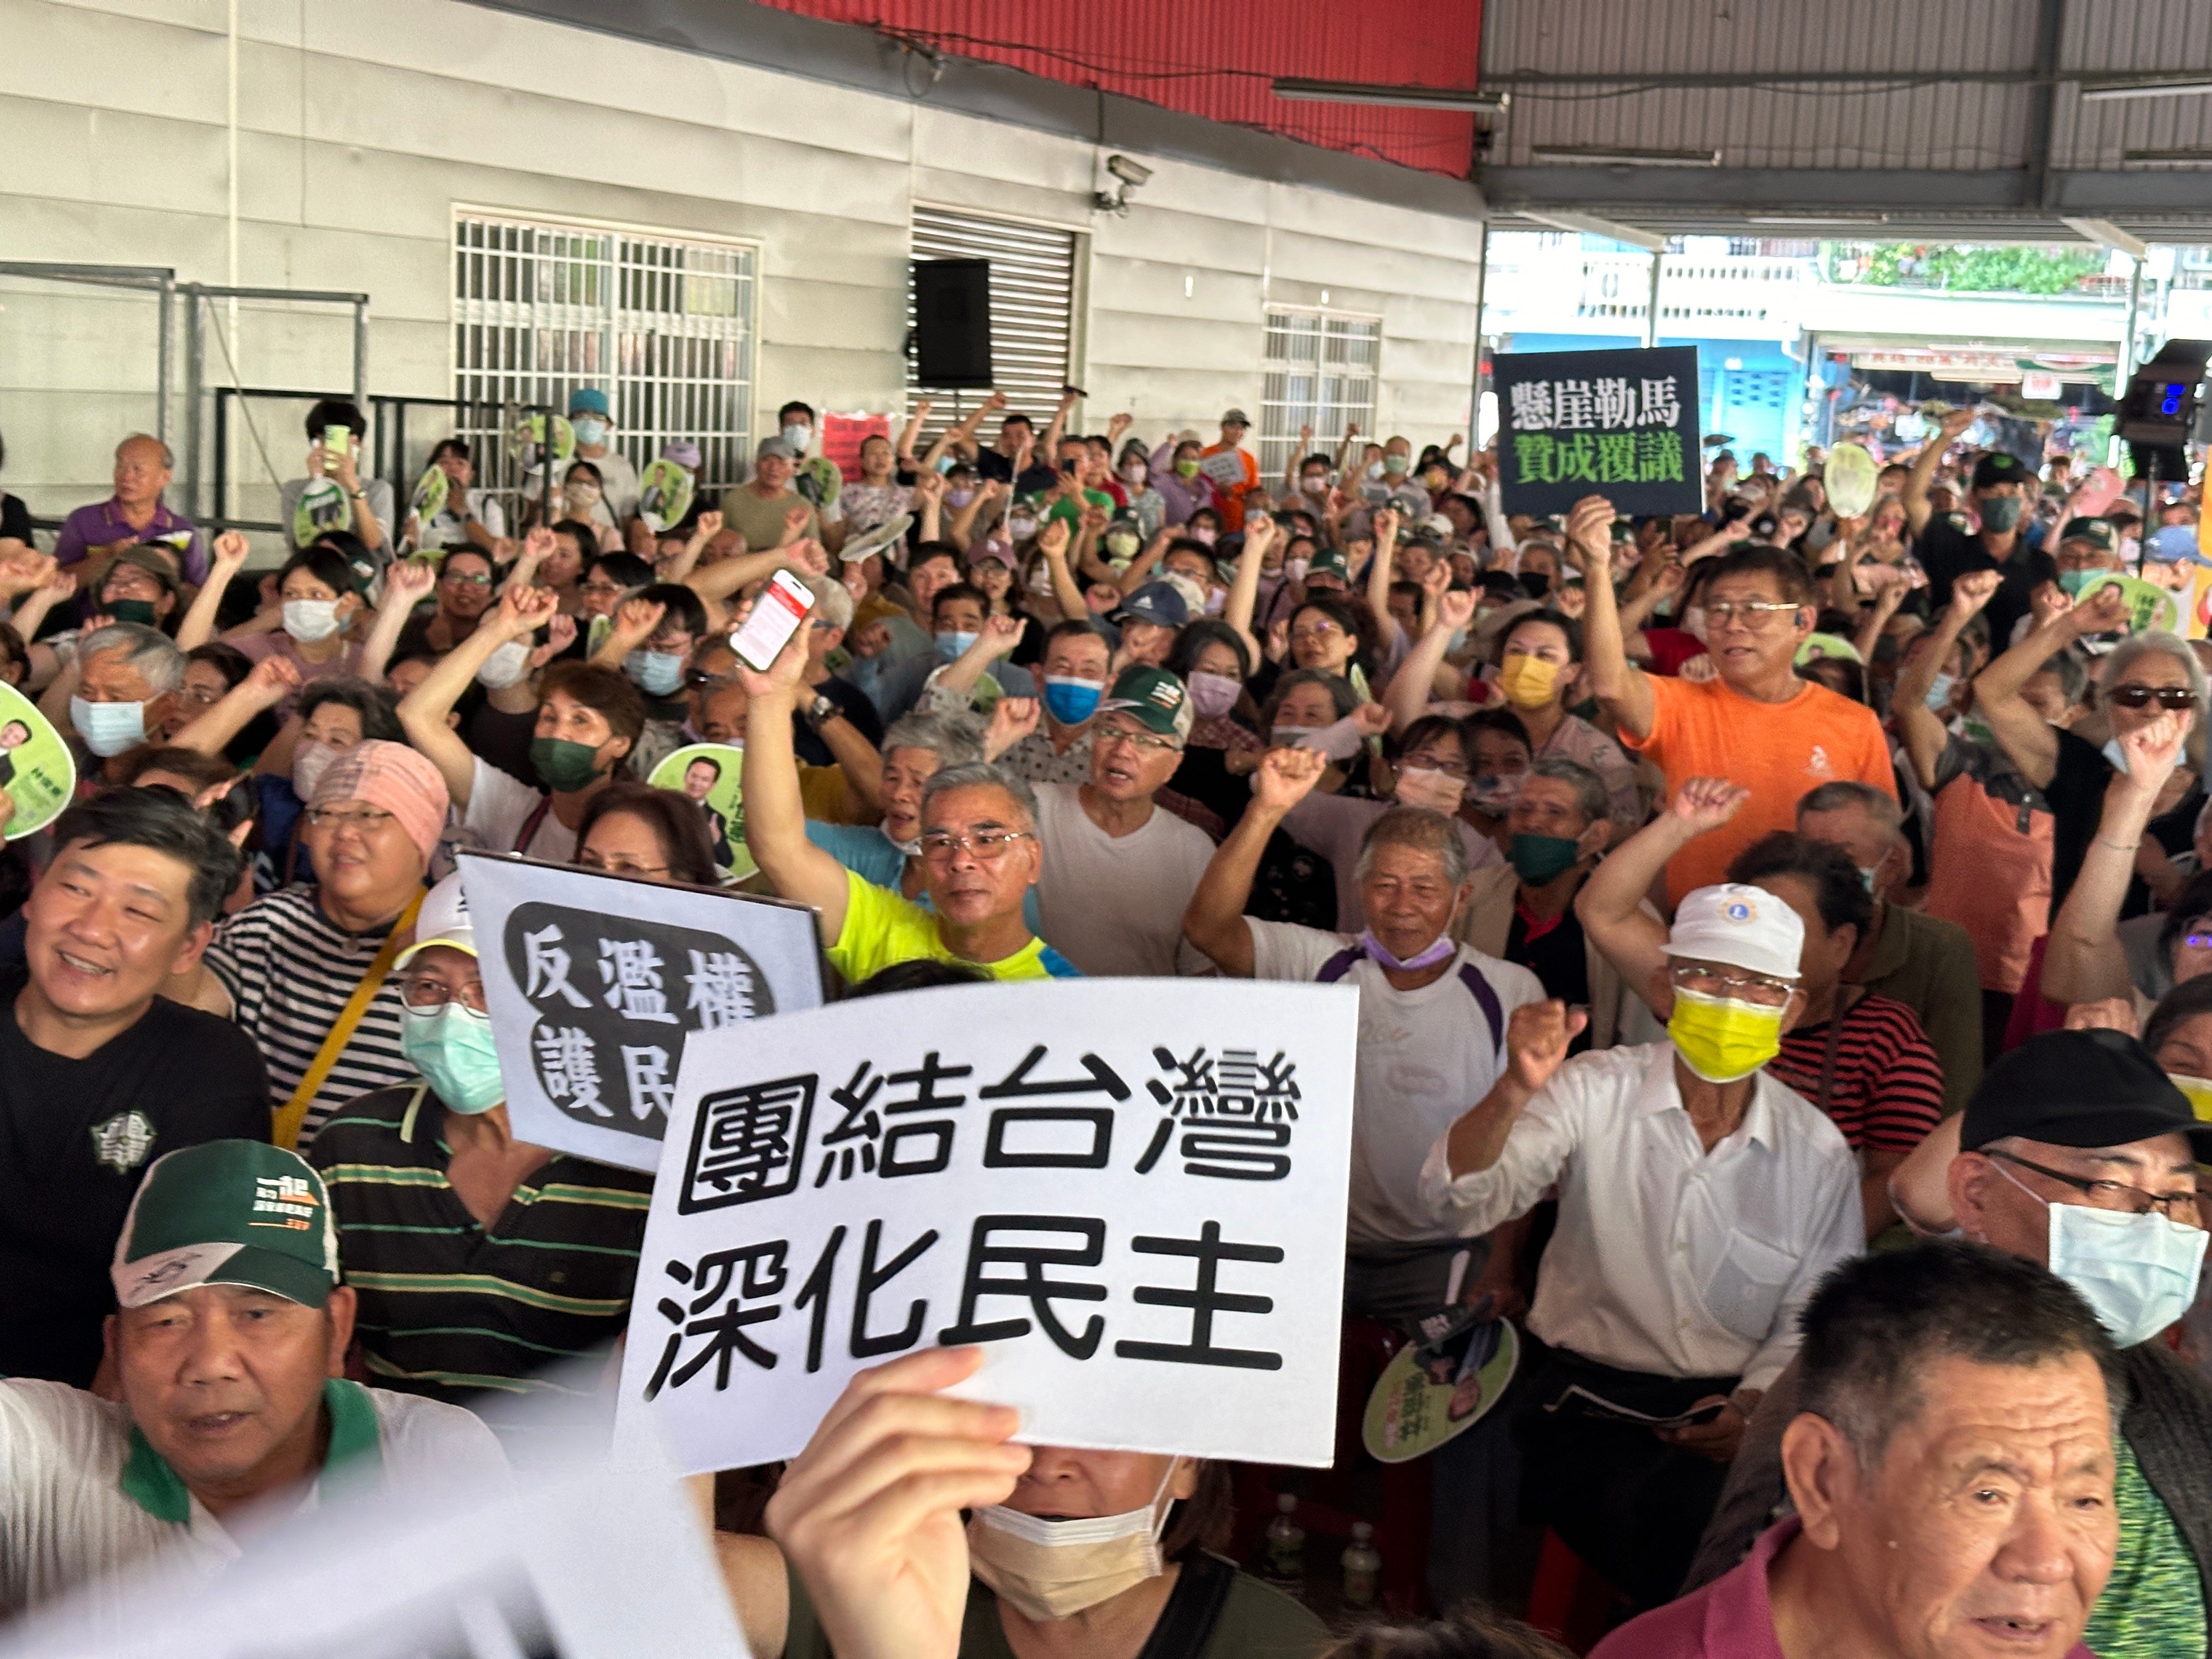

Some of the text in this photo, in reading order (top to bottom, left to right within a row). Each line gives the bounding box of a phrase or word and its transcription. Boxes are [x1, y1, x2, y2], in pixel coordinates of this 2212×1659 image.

[1511, 375, 1681, 430] 懸崖勒馬
[1514, 431, 1684, 484] 贊成覆議
[523, 924, 756, 1032] 反濫權
[678, 1044, 1302, 1215] 團結台灣
[644, 1215, 1284, 1402] 深化民主
